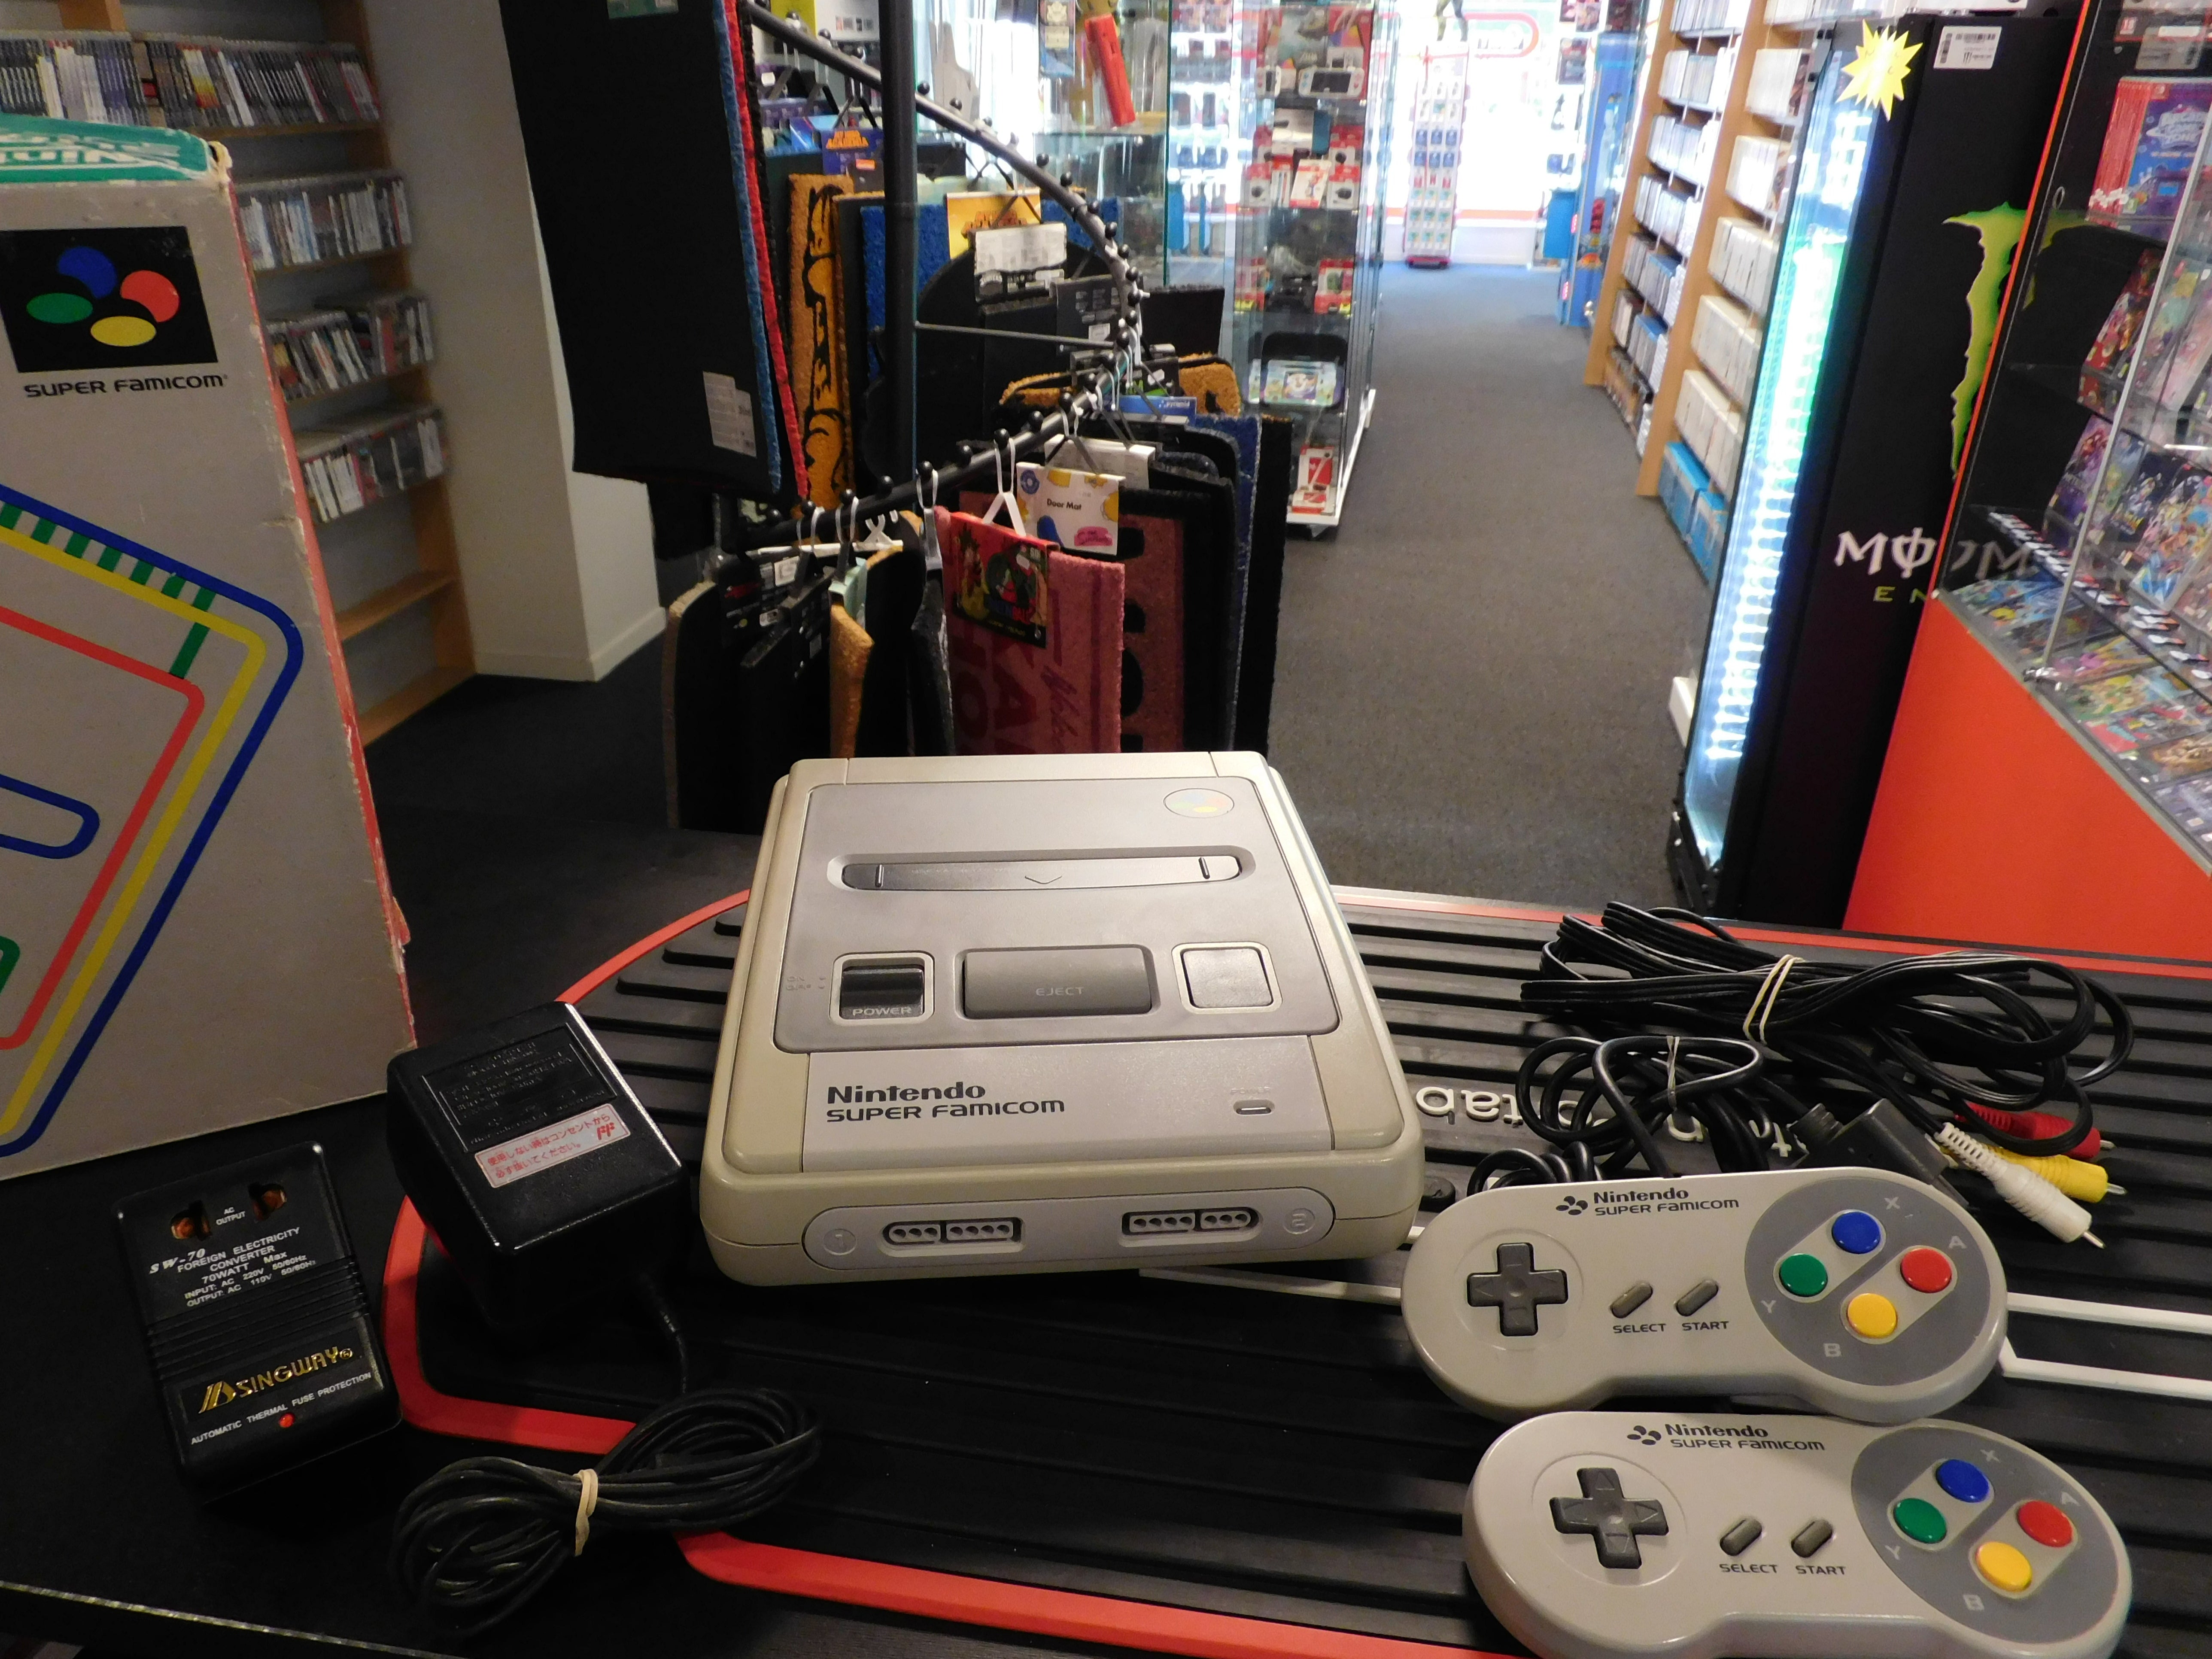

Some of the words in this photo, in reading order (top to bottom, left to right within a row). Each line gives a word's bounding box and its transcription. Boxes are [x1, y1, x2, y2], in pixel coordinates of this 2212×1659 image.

[24, 380, 106, 398] SUPER
[1047, 498, 1065, 508] Door
[1066, 502, 1082, 510] Mat
[1036, 986, 1084, 997] EJECT
[852, 1006, 912, 1017] POWER
[827, 1082, 986, 1104] Nintendo
[826, 1106, 922, 1122] SUPER
[1594, 1187, 1689, 1203] Nintendo
[1595, 1204, 1651, 1216] SUPER
[1884, 1196, 1901, 1210] X
[223, 1206, 235, 1215] AC
[216, 1211, 246, 1225] OUTPUT
[1948, 1235, 1967, 1249] A
[178, 1251, 226, 1273] FOREIGN
[233, 1227, 300, 1255] ELECTRICITY
[210, 1245, 275, 1272] CONVERTER
[201, 1263, 249, 1284] 70WATT
[263, 1251, 288, 1264] Max
[184, 1284, 217, 1300] INPUT:
[221, 1278, 234, 1288] AC
[243, 1267, 264, 1281] 220V
[272, 1253, 307, 1271] 50/60Hz
[186, 1290, 225, 1308] OUTPUT:
[228, 1284, 242, 1294] AC
[250, 1273, 273, 1286] 110V
[1761, 1300, 1777, 1313] Y
[1613, 1323, 1666, 1334] SELECT
[1682, 1321, 1729, 1331] START
[1823, 1342, 1841, 1357] B
[191, 1420, 242, 1445] AUTOMATIC
[246, 1404, 288, 1423] THERMAL
[292, 1392, 315, 1407] FUSE
[317, 1371, 371, 1398] PROTECTION
[1665, 1423, 1768, 1437] Nintendo
[1670, 1439, 1732, 1449] SUPER
[1980, 1449, 2001, 1463] X
[2060, 1491, 2081, 1507] A
[1884, 1544, 1901, 1561] Y
[1719, 1564, 1779, 1574] SELECT
[1795, 1565, 1846, 1576] START
[1963, 1594, 1985, 1611] B
